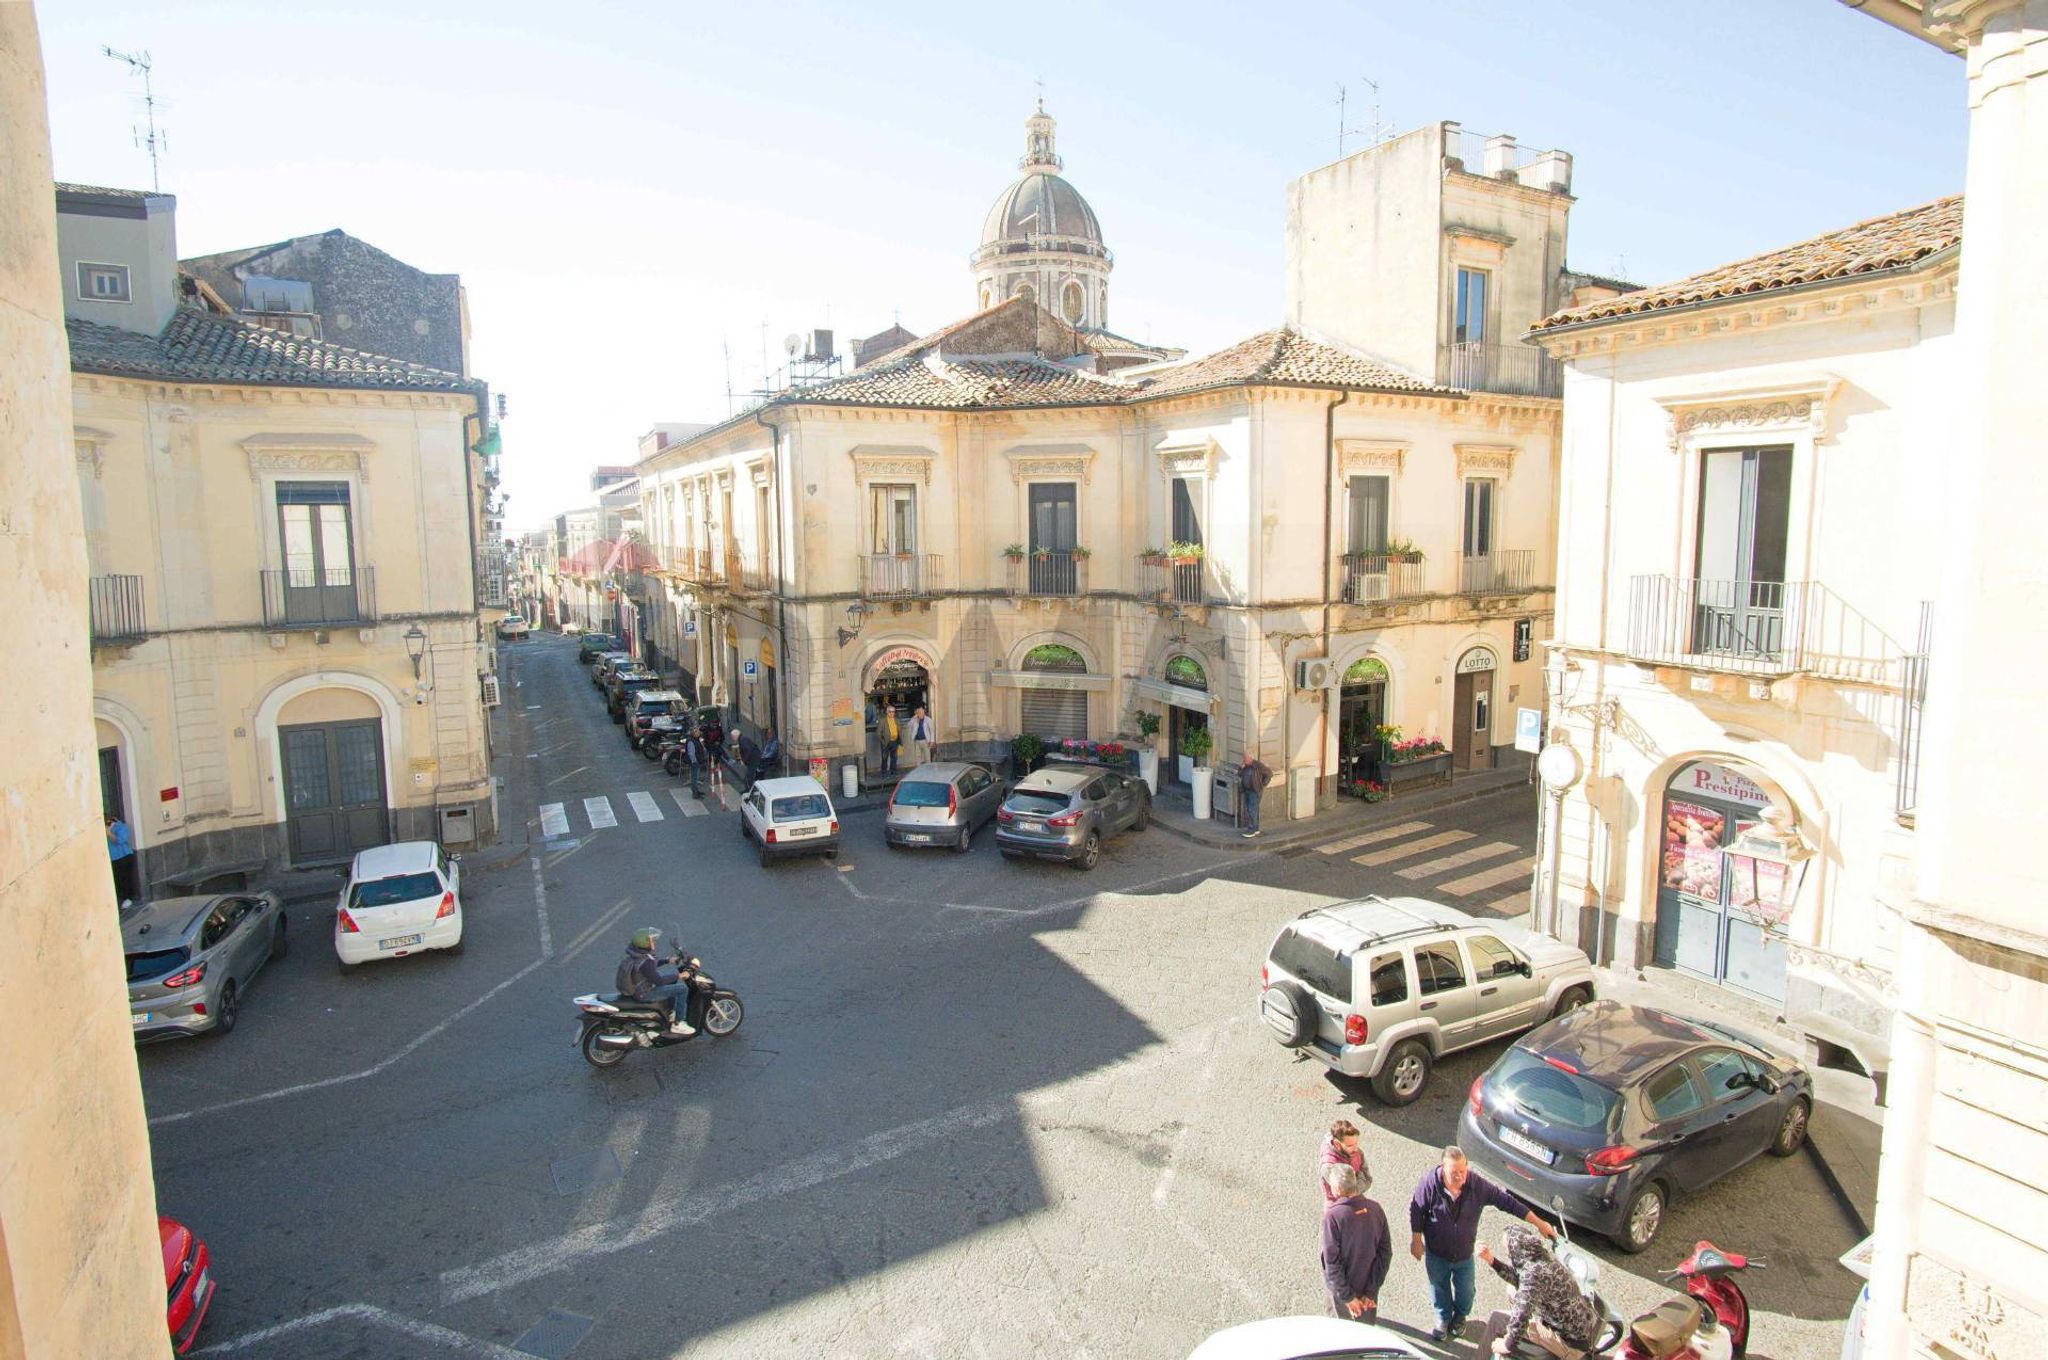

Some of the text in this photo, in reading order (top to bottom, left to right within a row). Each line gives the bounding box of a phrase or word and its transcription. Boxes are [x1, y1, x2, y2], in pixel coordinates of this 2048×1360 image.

[1465, 657, 1490, 667] LOTTO
[746, 663, 753, 673] P
[1521, 711, 1537, 733] P
